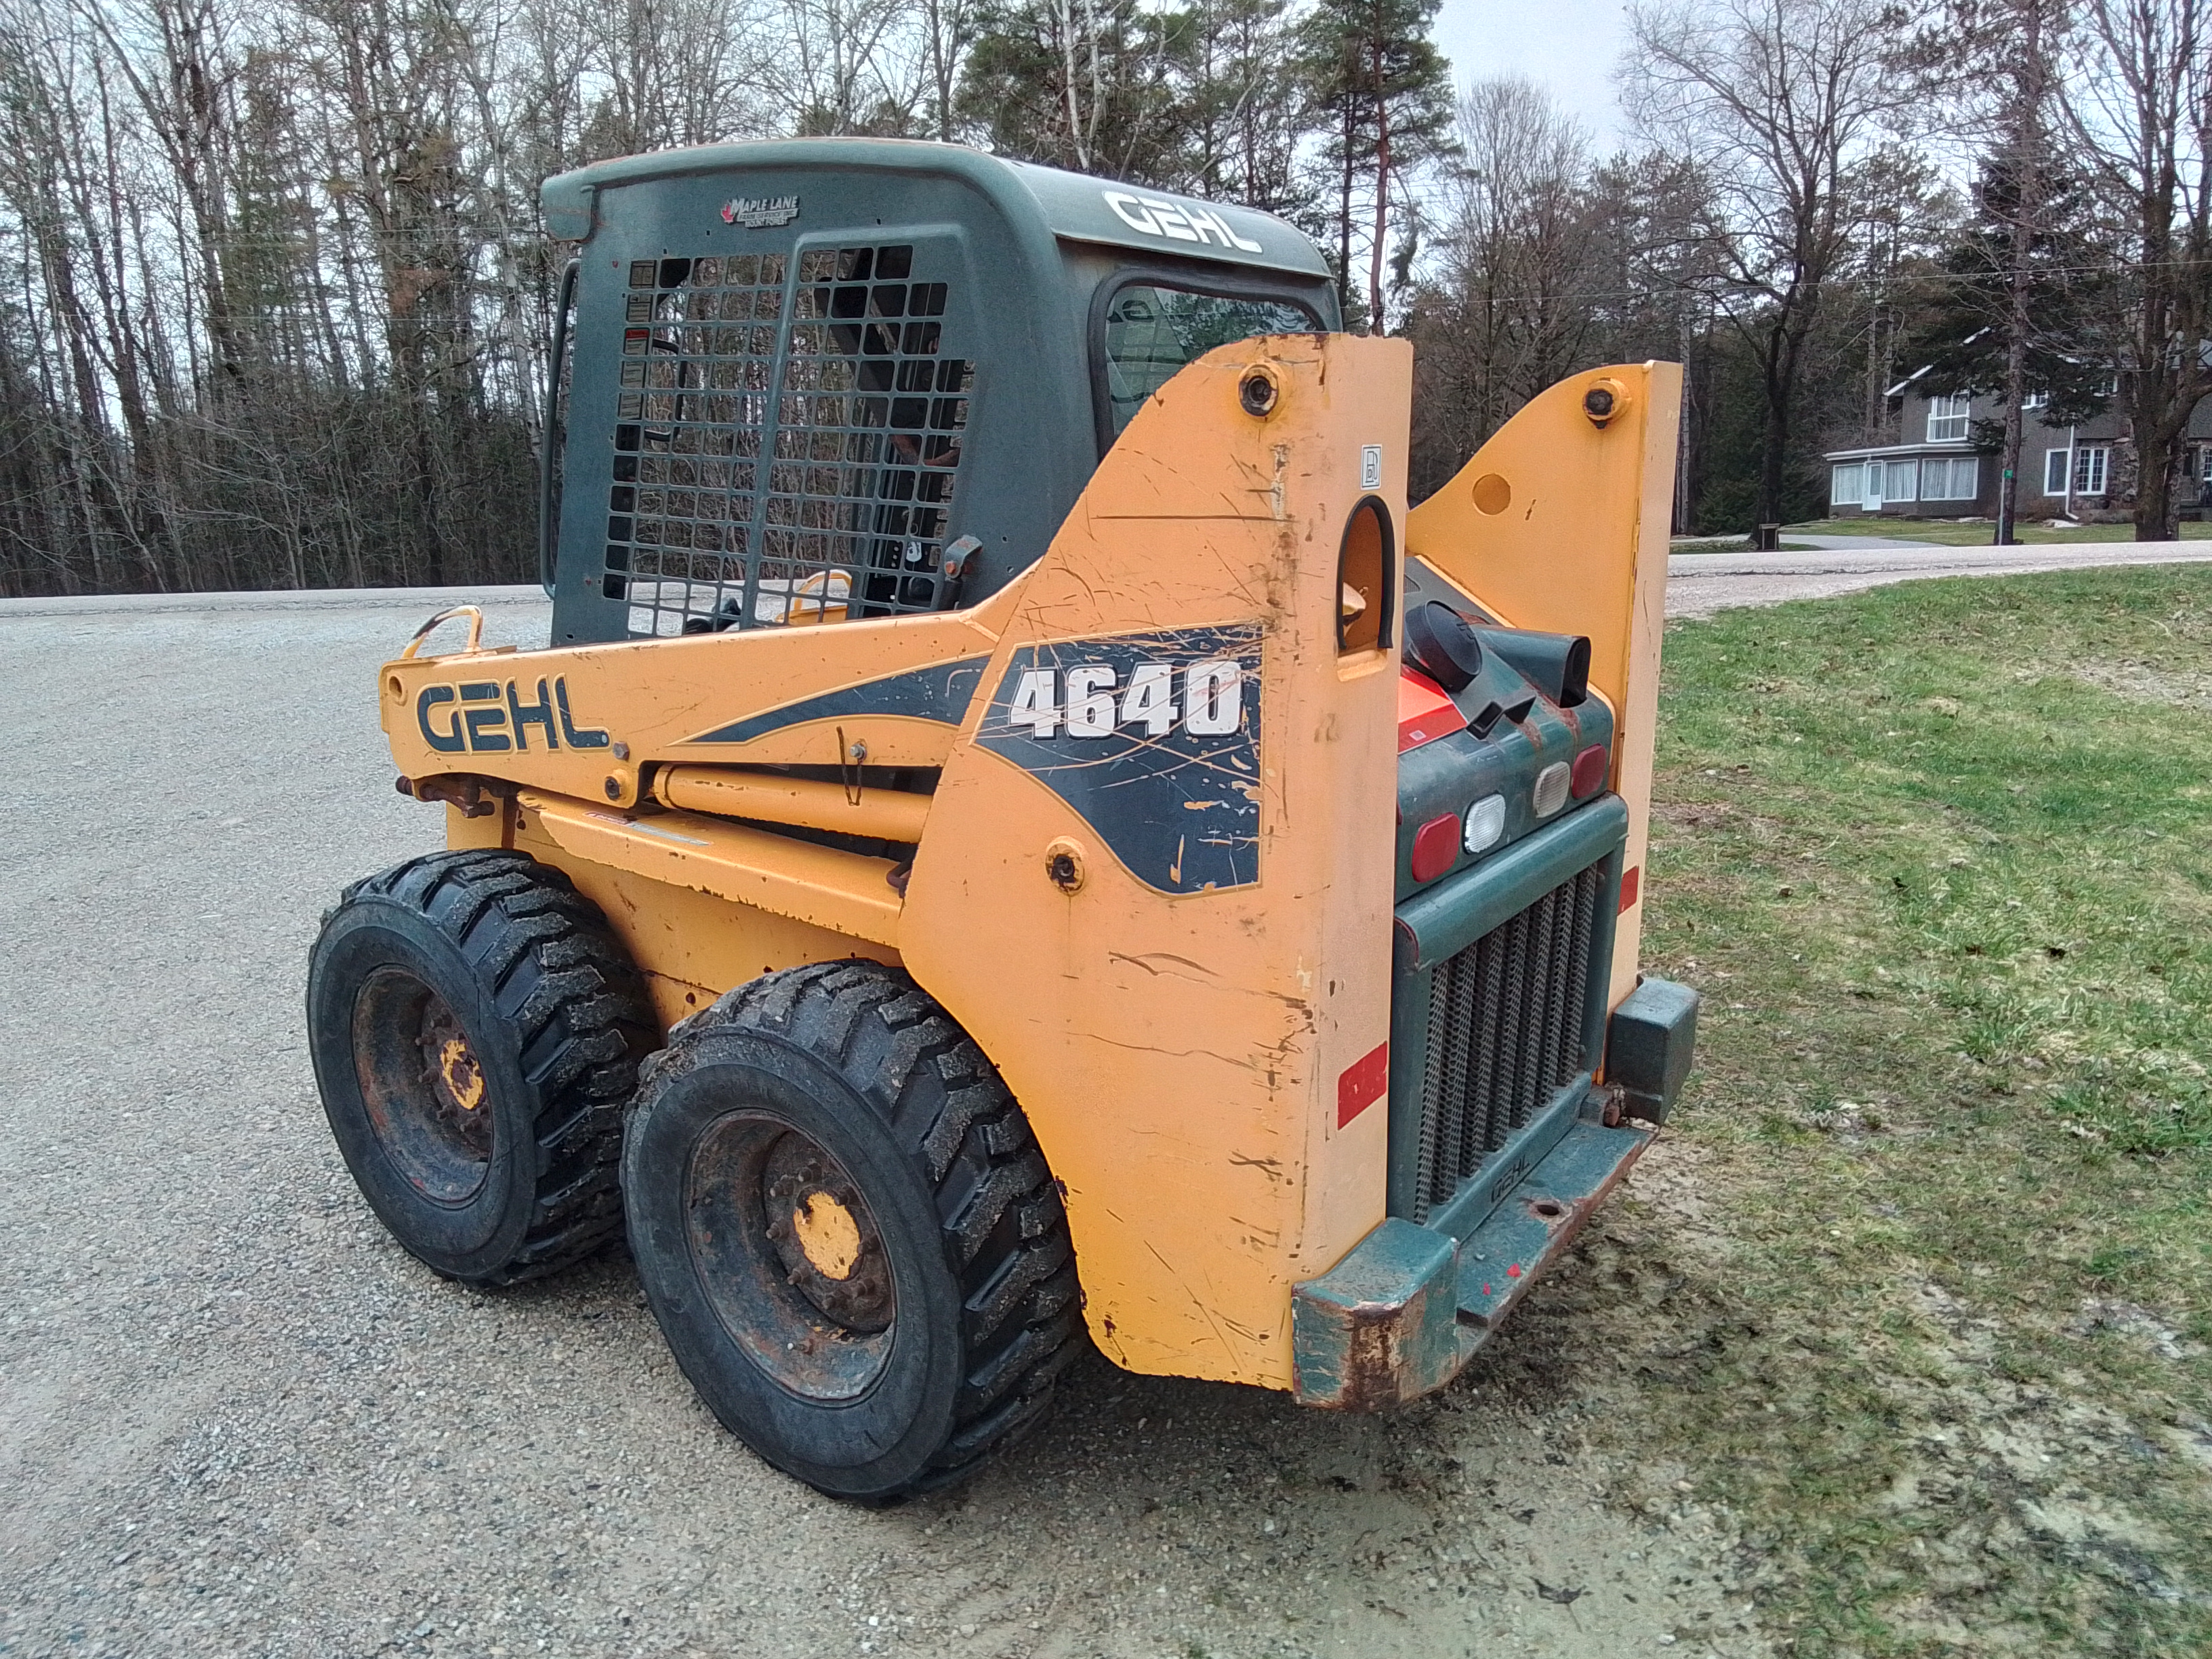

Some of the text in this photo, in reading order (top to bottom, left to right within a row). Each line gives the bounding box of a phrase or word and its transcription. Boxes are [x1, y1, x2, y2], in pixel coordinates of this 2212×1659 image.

[731, 196, 798, 213] MAPLE LANE
[1102, 191, 1263, 253] GEHL
[417, 676, 611, 753] GEHL
[1009, 661, 1242, 738] 4640
[1491, 1154, 1530, 1203] GEHL
